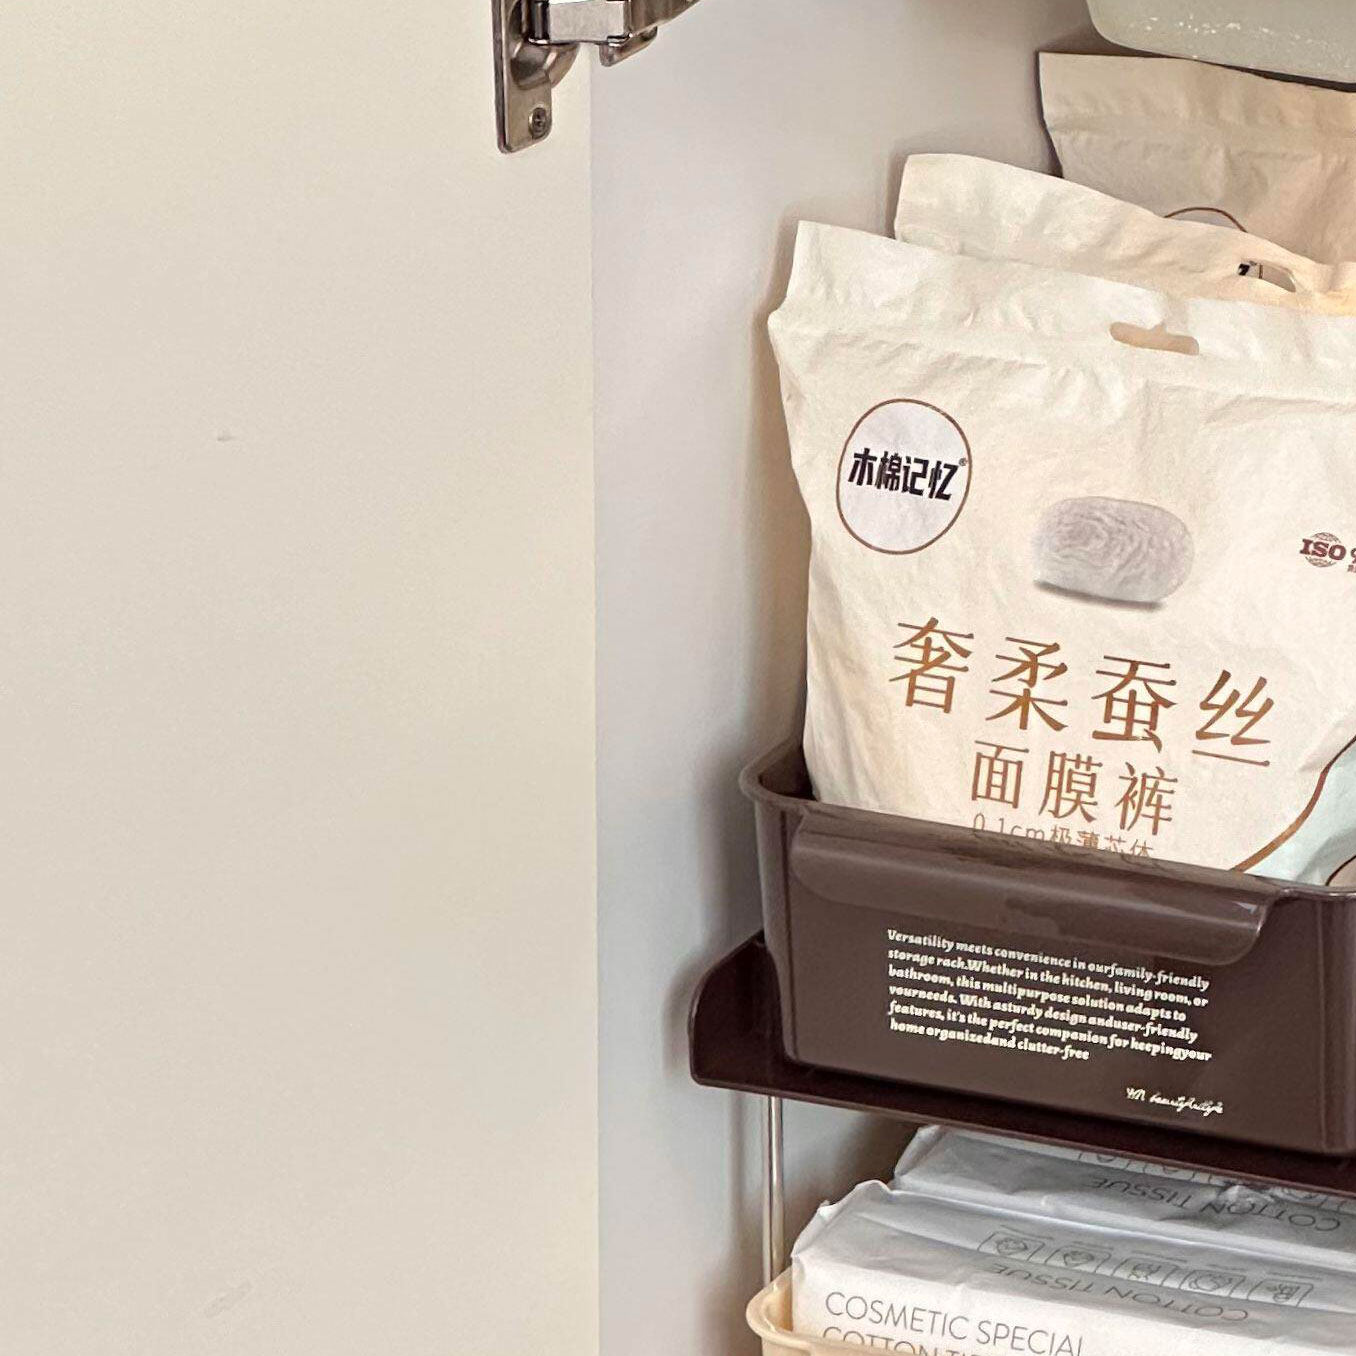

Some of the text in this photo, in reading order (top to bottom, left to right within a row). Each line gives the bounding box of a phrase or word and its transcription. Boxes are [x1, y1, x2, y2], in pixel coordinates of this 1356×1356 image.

[848, 447, 958, 500] 木棉记忆
[1299, 538, 1347, 561] ISO
[888, 616, 1275, 767] 奢柔蚕丝
[971, 739, 1179, 836] 面膜裤
[887, 929, 1086, 970] Versatility meets convenience in
[888, 949, 935, 966] storage
[1025, 967, 1038, 981] in
[1040, 970, 1061, 984] the
[1114, 981, 1153, 1001] living
[1193, 997, 1209, 1007] or
[956, 975, 981, 990] this
[982, 981, 1071, 1004] multipurpose
[1071, 994, 1124, 1012] solution
[1125, 1002, 1172, 1020] adapts
[1173, 1010, 1186, 1021] to
[890, 1017, 925, 1034] home
[959, 993, 992, 1009] With
[1044, 1006, 1087, 1025] design
[967, 1012, 988, 1026] the
[989, 1018, 1035, 1038] perfect
[1035, 1026, 1108, 1045] companion
[1107, 1034, 1129, 1049] for
[825, 1291, 969, 1340] COSMETIC
[985, 1263, 1250, 1322] COTTON TISSUE
